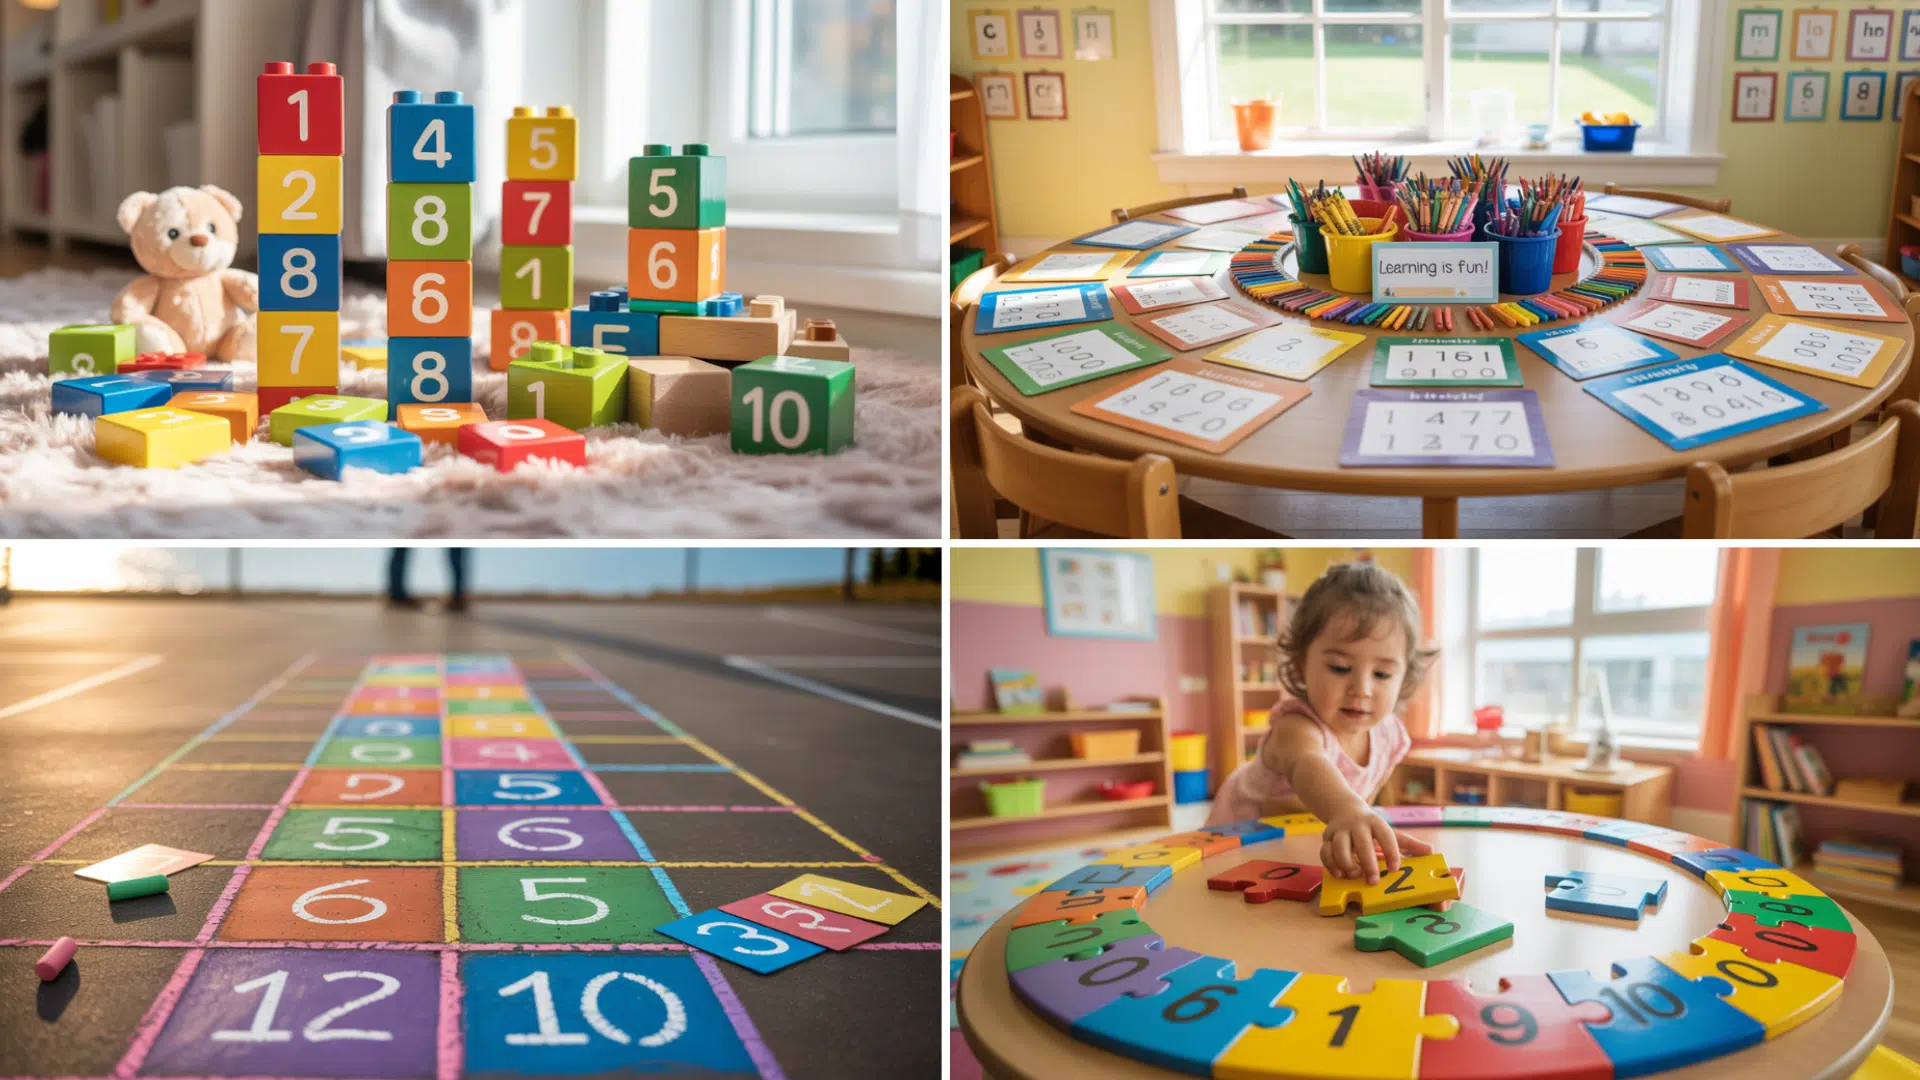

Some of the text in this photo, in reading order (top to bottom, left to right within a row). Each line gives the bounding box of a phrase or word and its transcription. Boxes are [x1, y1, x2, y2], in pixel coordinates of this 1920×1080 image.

[287, 89, 309, 141] 1
[412, 119, 452, 168] 4
[529, 127, 558, 170] 5
[281, 170, 317, 220] 2
[522, 192, 551, 235] 7
[648, 168, 678, 217] 5
[411, 195, 448, 246] 8
[280, 248, 318, 298] 8
[515, 258, 542, 299] 1
[648, 241, 678, 289] 6
[1379, 259, 1489, 277] Learning is fun!
[411, 272, 448, 324] 6
[280, 325, 315, 374] 7
[509, 321, 538, 358] 8
[410, 351, 449, 402] 8
[527, 381, 545, 419] 1
[742, 387, 811, 448] 10
[493, 773, 562, 801] 5
[313, 816, 583, 852] 5 6
[292, 876, 610, 926] 6 5
[1380, 866, 1415, 894] 2
[696, 921, 790, 956] 3
[1078, 956, 1150, 987] 0
[1716, 960, 1778, 988] 0
[211, 970, 687, 1046] 12 10
[1162, 984, 1239, 1024] 6
[1480, 1002, 1538, 1046] 9
[1602, 981, 1686, 1026] 10
[1327, 1004, 1361, 1048] 1
